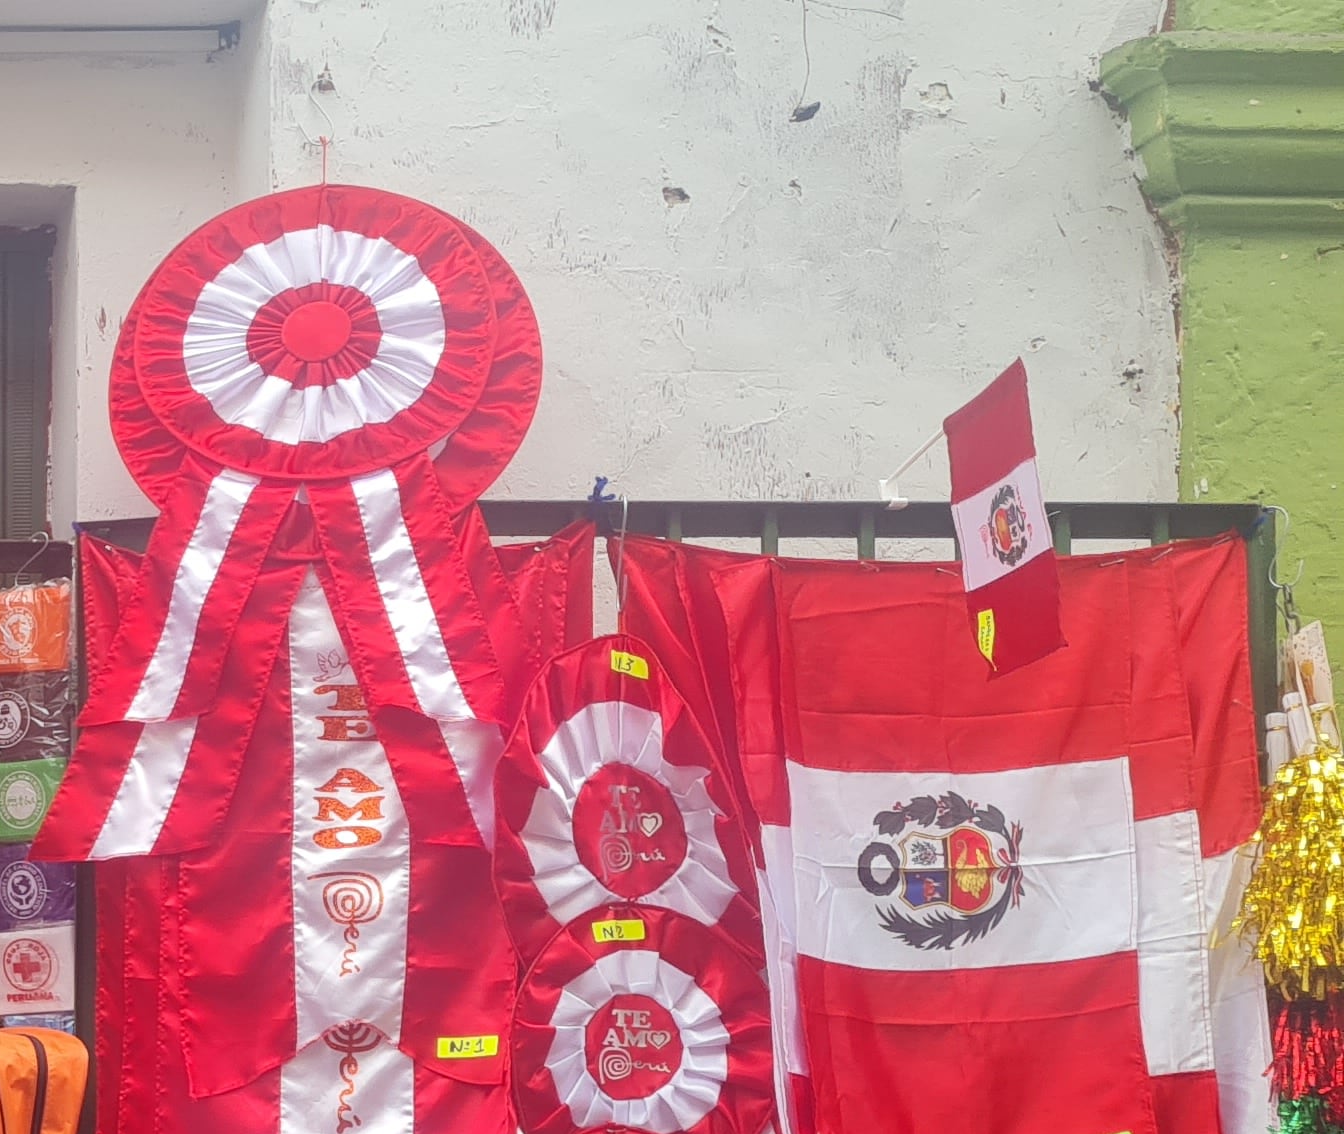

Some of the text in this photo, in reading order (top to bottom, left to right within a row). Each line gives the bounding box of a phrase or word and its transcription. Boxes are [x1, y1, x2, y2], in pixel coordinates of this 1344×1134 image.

[312, 767, 385, 849] AMO
[6, 991, 55, 1003] PERUANA
[612, 1009, 651, 1028] TE
